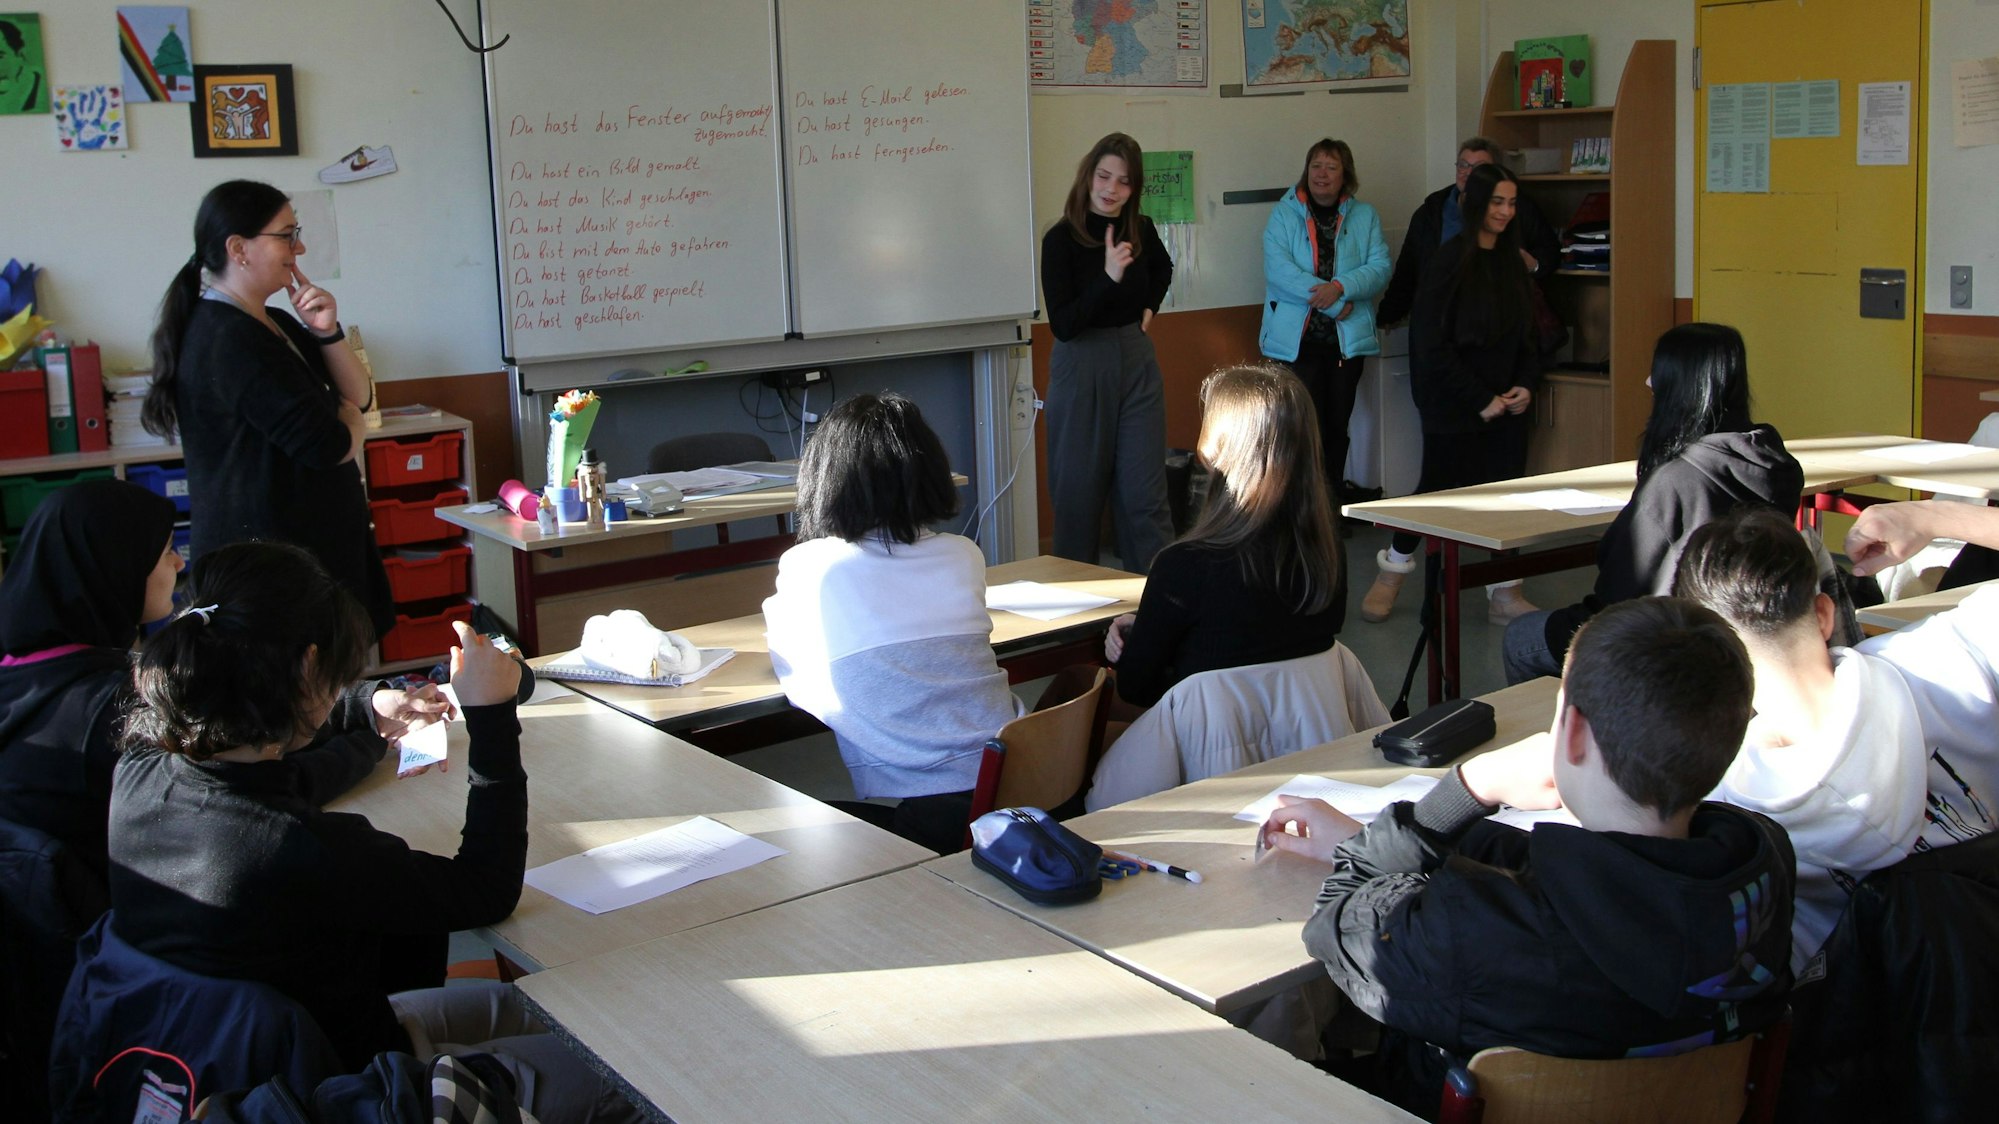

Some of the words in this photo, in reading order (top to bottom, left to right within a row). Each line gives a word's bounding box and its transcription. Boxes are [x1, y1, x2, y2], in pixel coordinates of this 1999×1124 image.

[796, 91, 815, 108] Du
[823, 90, 848, 105] hast
[861, 85, 912, 108] E-Mail
[510, 114, 533, 137] Du
[545, 112, 578, 134] hast
[596, 110, 618, 132] das
[627, 105, 690, 128] Fenster
[798, 116, 818, 133] Du
[824, 114, 850, 131] hast
[864, 116, 929, 136] gesungen.
[694, 124, 767, 146] zugemacht.
[799, 145, 818, 166] Du
[831, 144, 861, 160] hast
[874, 137, 954, 163] ferngesehen.
[511, 161, 532, 181] Du
[542, 163, 570, 178] hast
[578, 165, 600, 177] ein
[609, 157, 640, 176] Bild
[509, 190, 528, 209] Du
[537, 191, 560, 207] hast
[568, 189, 589, 206] das
[602, 187, 632, 208] Kind
[640, 187, 712, 209] geschlagen.
[510, 217, 528, 234] Du
[537, 217, 562, 233] hast
[626, 214, 674, 235] gehört.
[513, 242, 529, 260] Du
[540, 240, 563, 259] bist
[573, 241, 598, 258] mit
[605, 240, 629, 257] dem
[635, 239, 661, 256] Auto
[515, 267, 532, 285] Du
[541, 265, 566, 281] hast
[516, 290, 534, 308] Du
[542, 289, 566, 305] hast
[515, 313, 533, 330] Du
[538, 312, 562, 328] hast
[575, 305, 644, 331] geschlafen.
